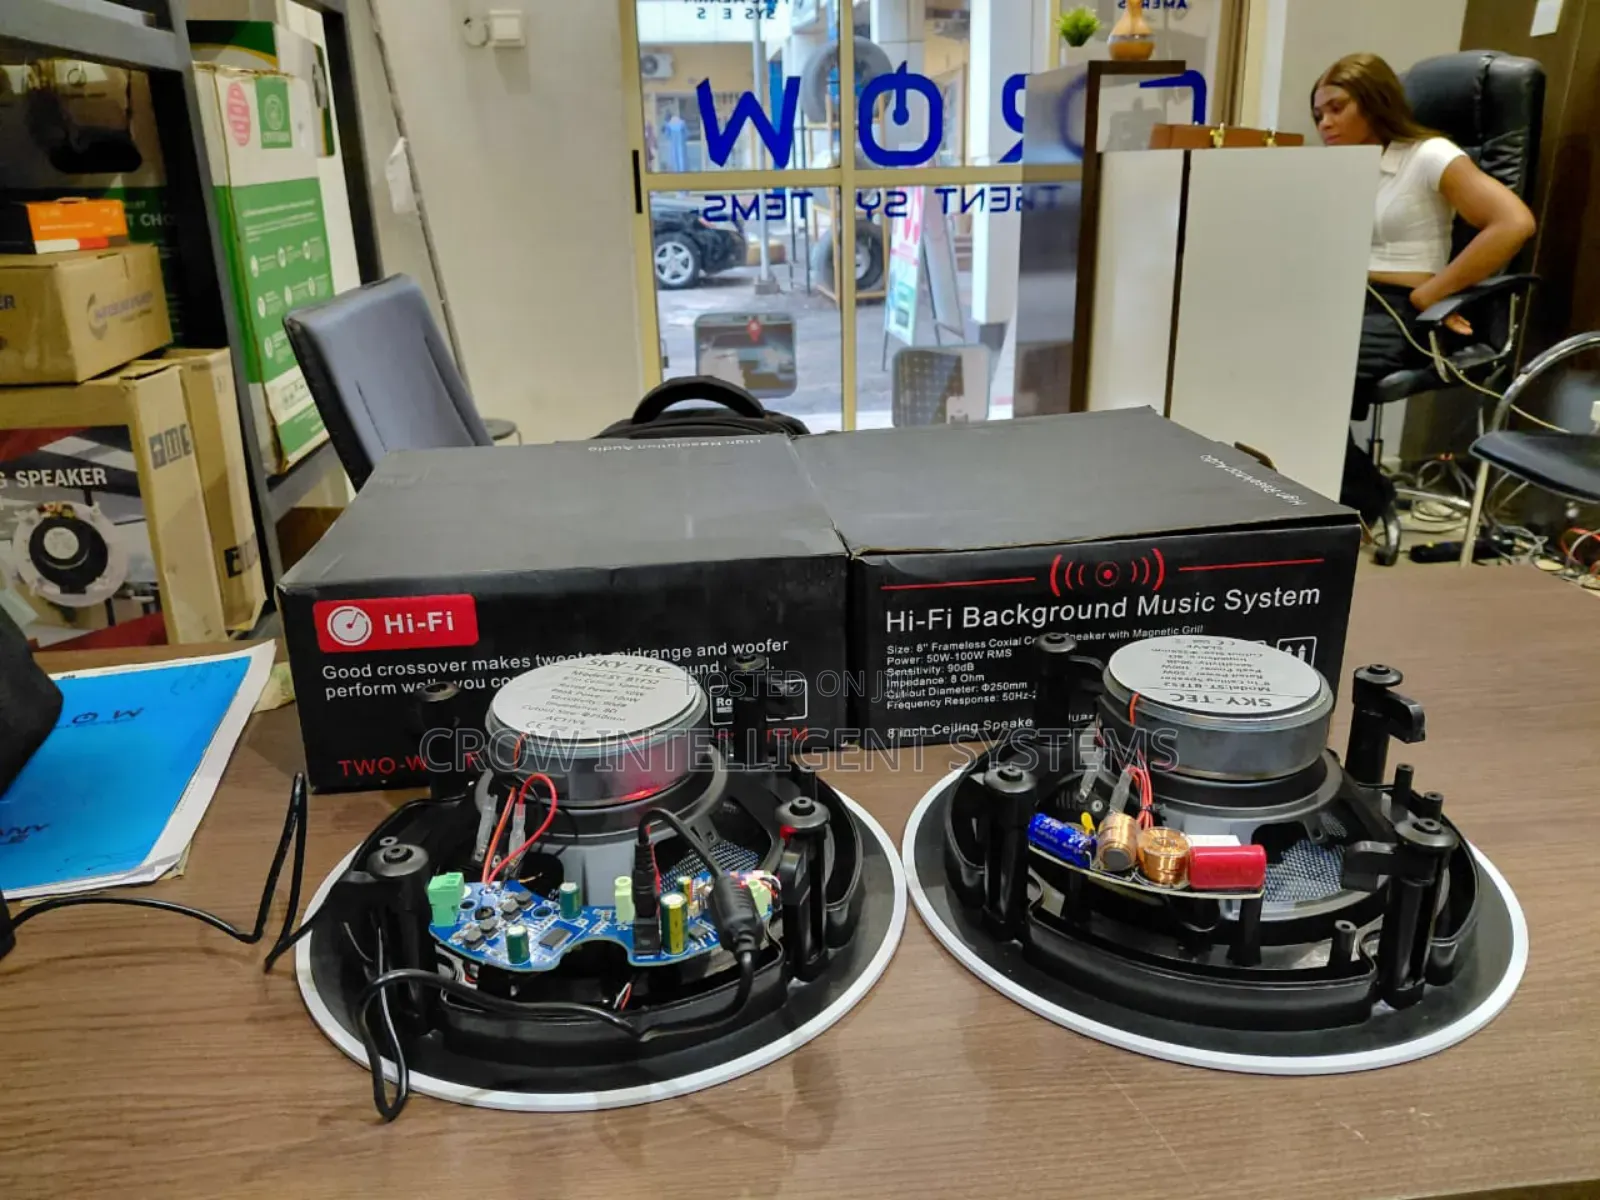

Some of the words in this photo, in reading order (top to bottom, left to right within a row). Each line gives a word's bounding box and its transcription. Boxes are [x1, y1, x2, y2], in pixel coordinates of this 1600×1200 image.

[15, 467, 108, 488] SPEAKER
[884, 608, 952, 632] Hi-Fi
[963, 597, 1127, 629] Background
[1138, 592, 1215, 617] Music
[1225, 586, 1321, 616] System
[384, 611, 455, 635] Hi-Fi
[931, 640, 986, 652] Frameless
[988, 637, 1022, 648] Coxial
[1109, 630, 1130, 640] with
[1132, 626, 1180, 639] Magnetic
[1181, 625, 1204, 636] Grill
[322, 664, 374, 680] Good
[377, 660, 468, 678] crossover
[472, 655, 531, 671] makes
[696, 642, 727, 657] and
[732, 638, 789, 656] woofer
[586, 658, 672, 675] SKY-TEC
[926, 651, 984, 664] 50W-100W
[987, 649, 1013, 659] RMS
[947, 663, 975, 673] 90dB
[960, 673, 985, 683] Ohm
[326, 681, 397, 701] perform
[928, 686, 979, 697] Diameter:
[1169, 693, 1272, 708] SKY-TEC
[886, 699, 942, 712] Frequency
[944, 694, 1000, 706] Response:
[899, 723, 928, 738] inch
[931, 721, 980, 735] Ceiling
[983, 717, 1034, 731] Speake
[337, 754, 427, 778] TWO-W
